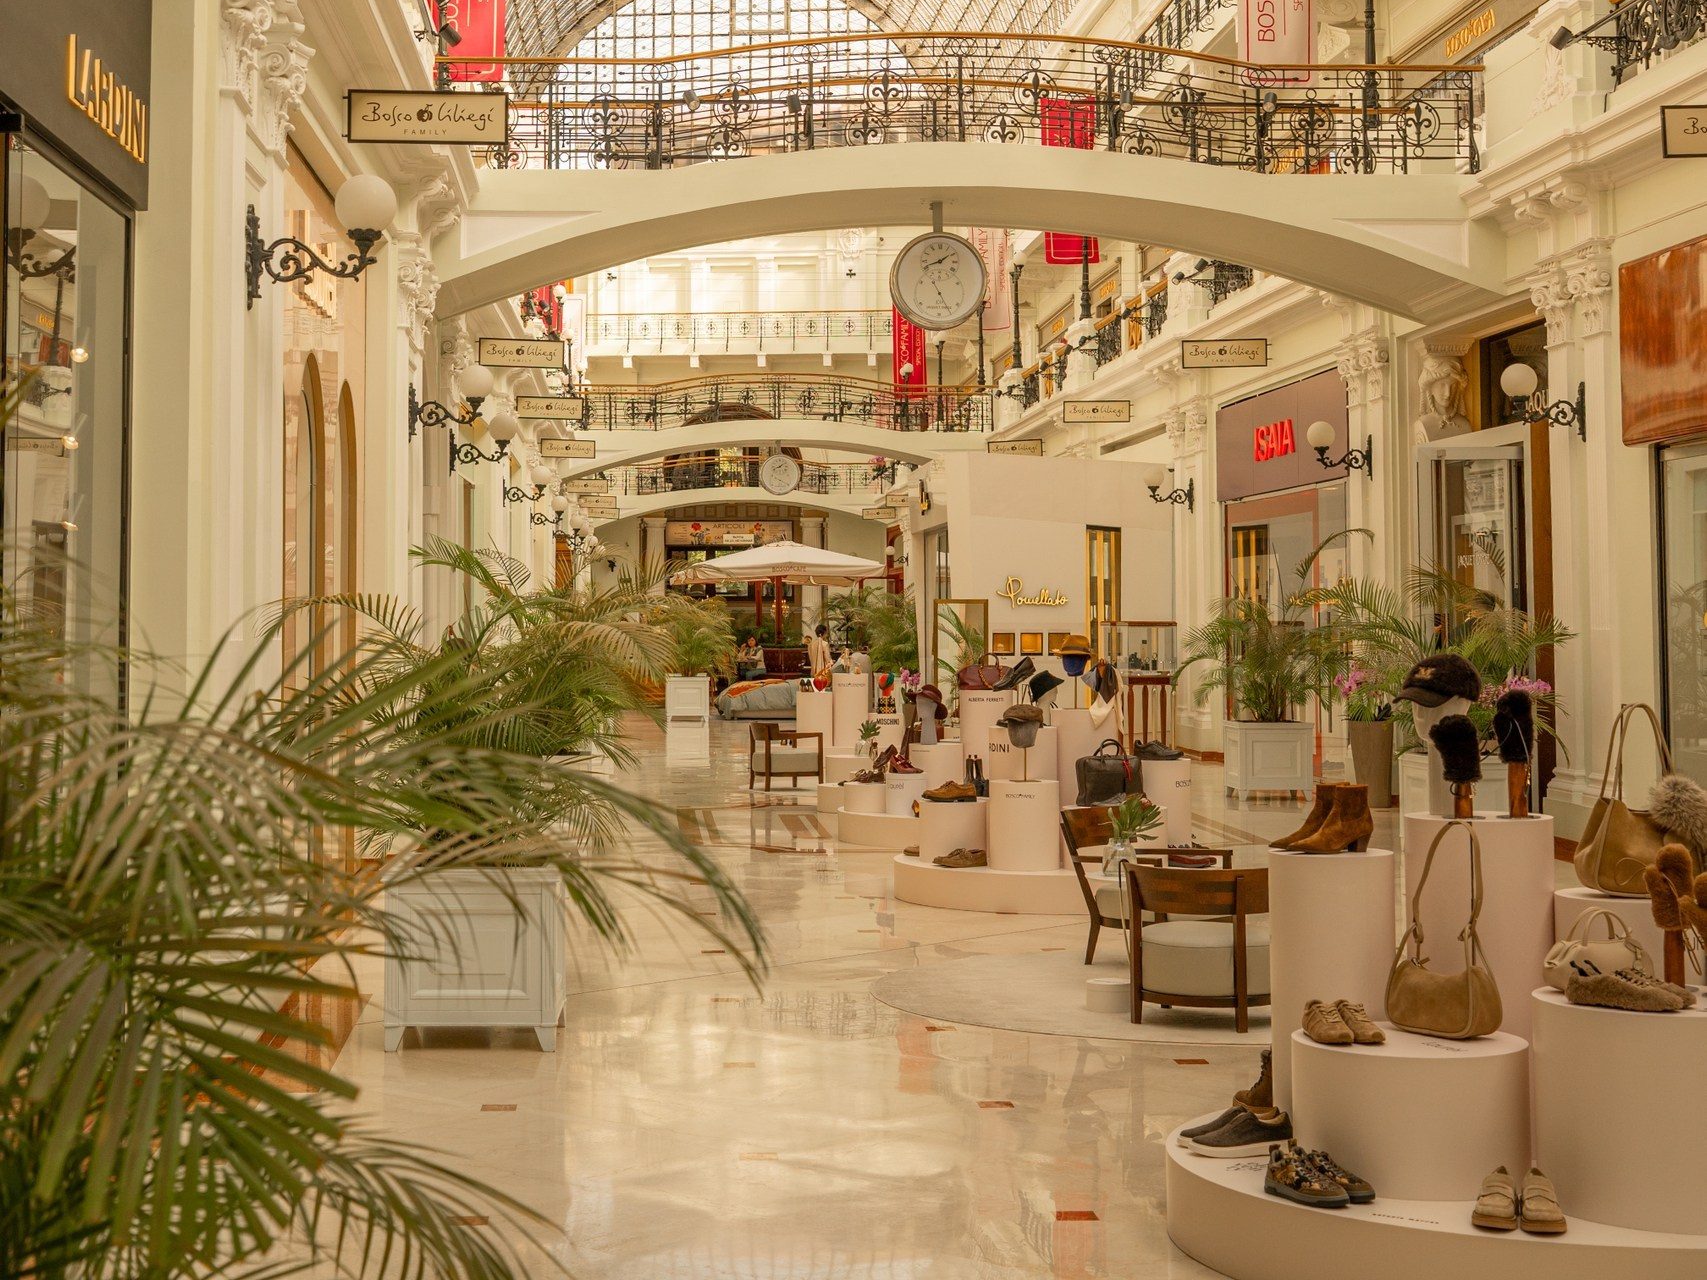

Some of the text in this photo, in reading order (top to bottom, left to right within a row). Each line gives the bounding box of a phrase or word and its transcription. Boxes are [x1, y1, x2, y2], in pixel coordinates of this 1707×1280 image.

[361, 102, 412, 127] Bosco
[486, 343, 514, 358] Bosco
[1188, 344, 1217, 359] Bosco
[1254, 418, 1296, 462] ISAIA
[996, 576, 1069, 609] Pomellato
